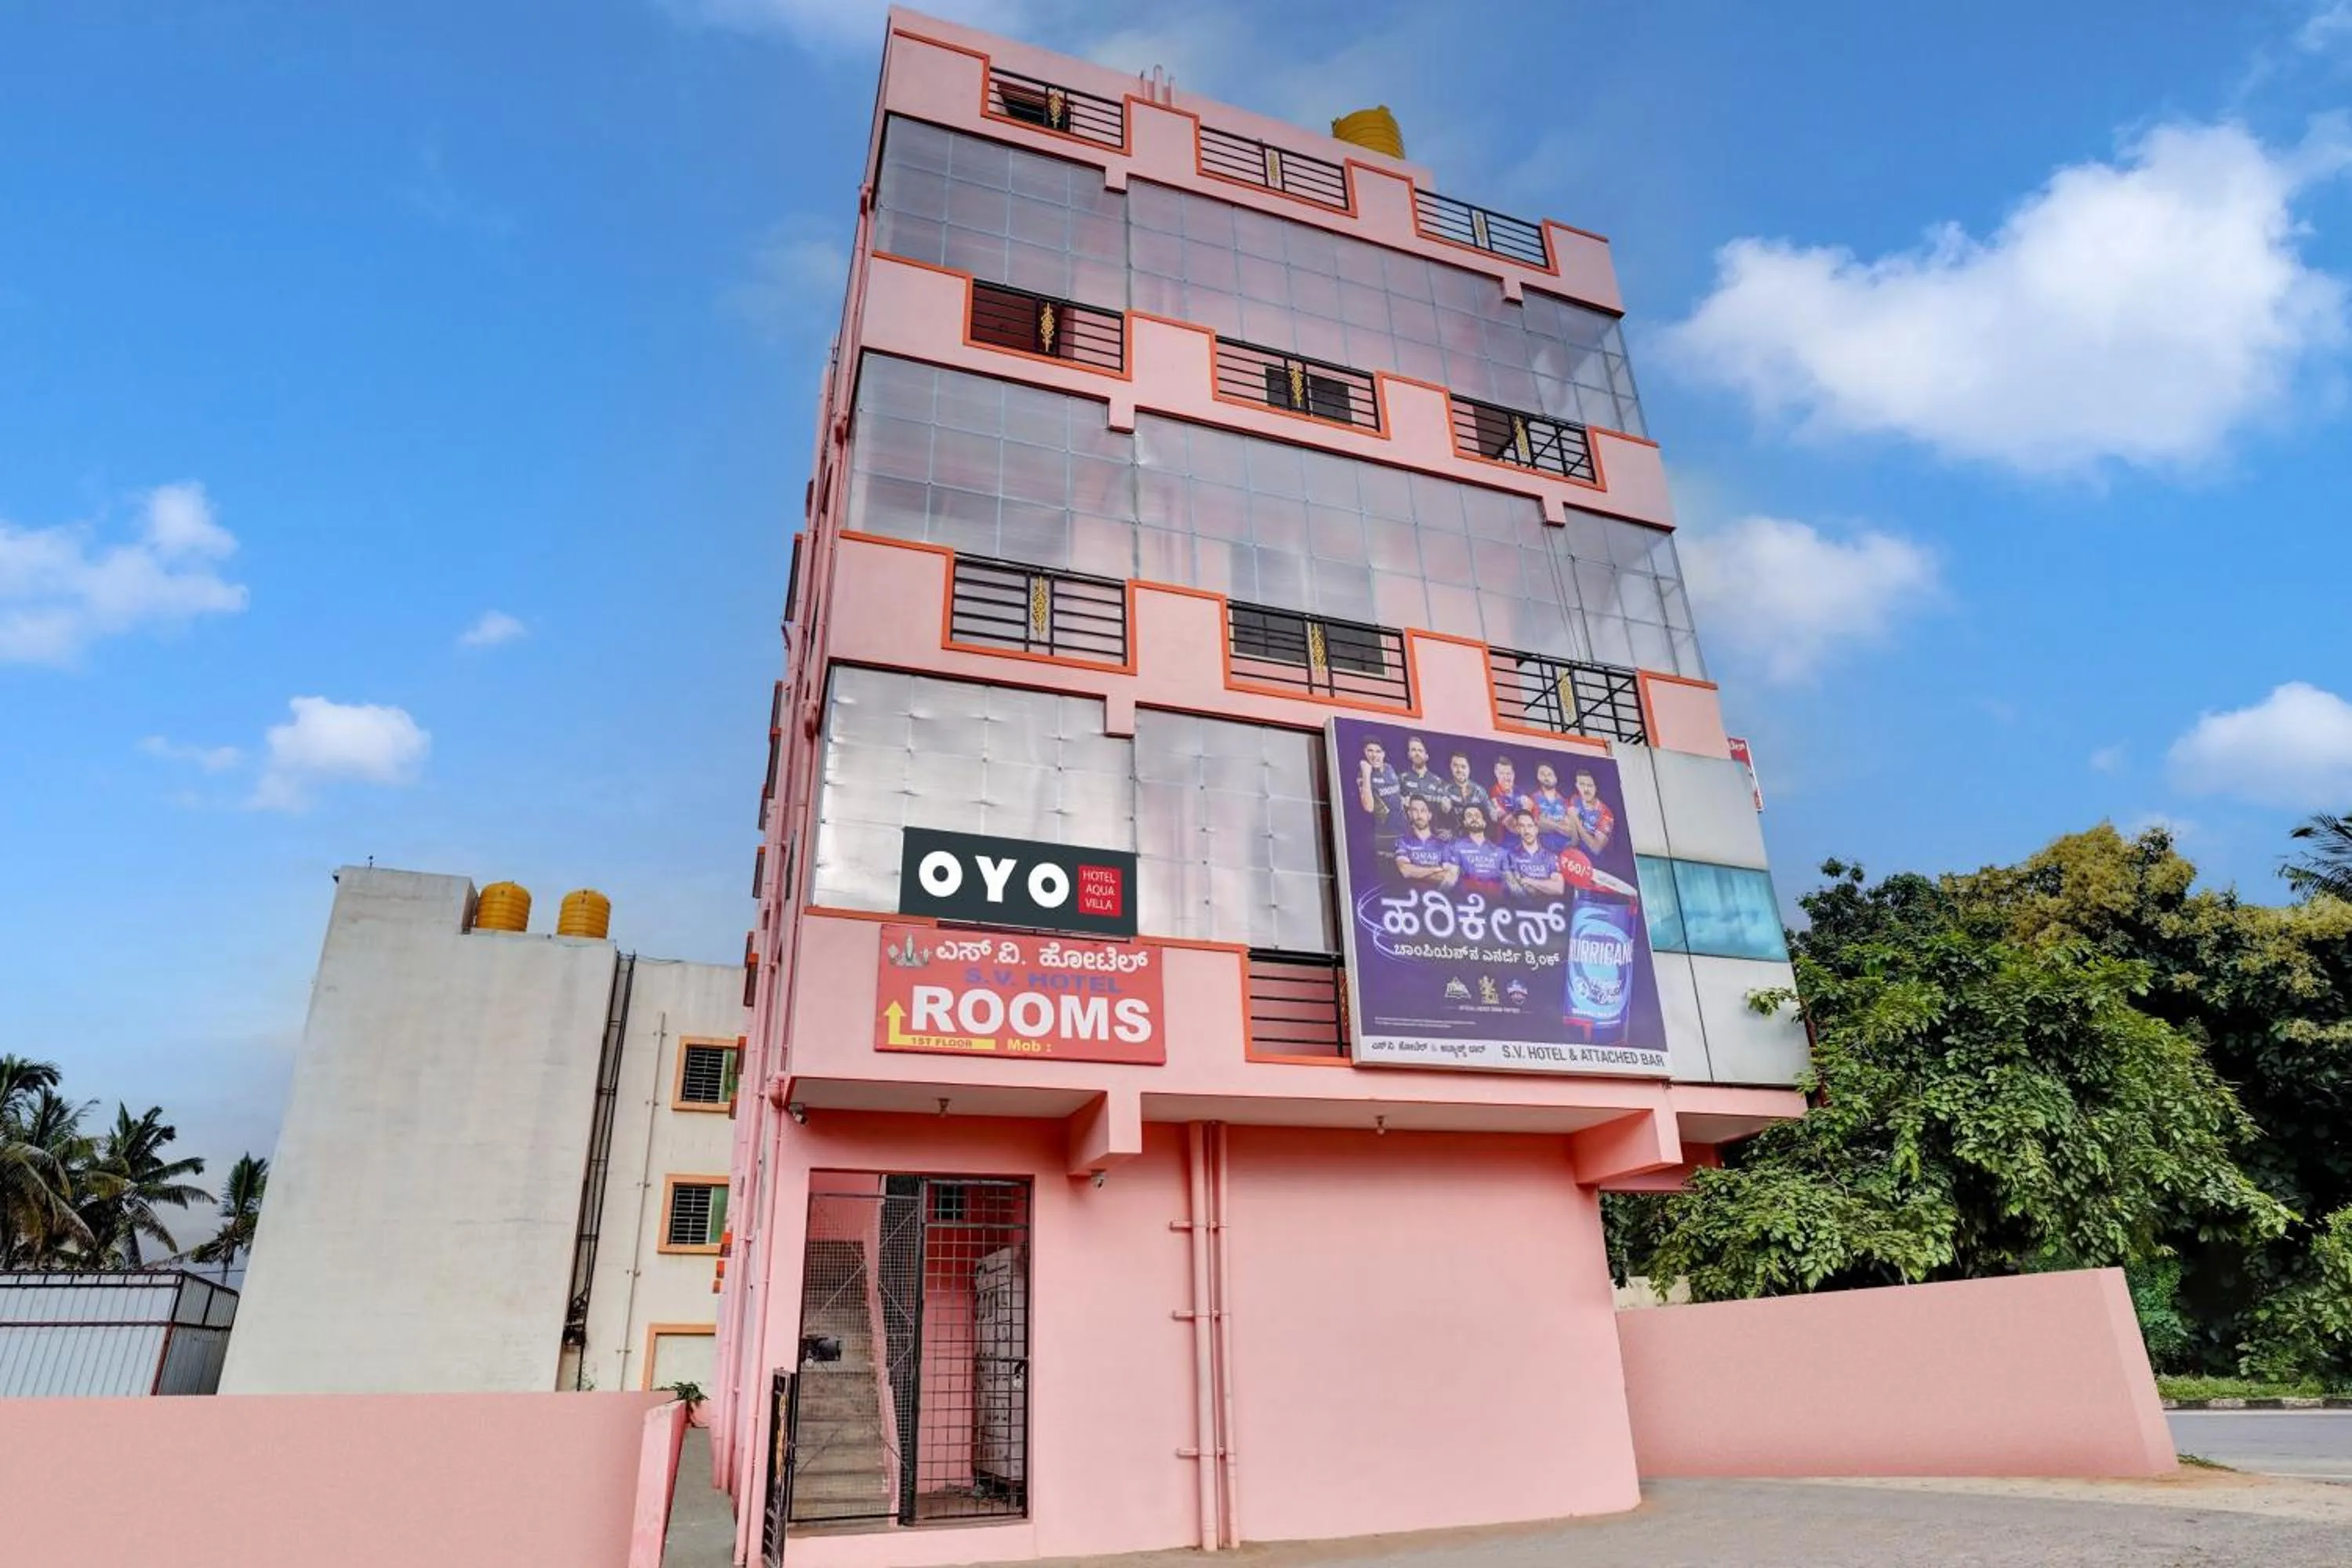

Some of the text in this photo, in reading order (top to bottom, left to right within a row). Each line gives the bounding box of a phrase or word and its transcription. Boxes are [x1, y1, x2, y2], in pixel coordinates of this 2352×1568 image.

[919, 851, 1069, 908] OYO
[1083, 871, 1116, 884] HOTEL
[1086, 884, 1115, 897] AQUA
[1085, 897, 1112, 910] VILLA
[1381, 889, 1566, 946] ಹರಿಕೇನ್
[1039, 942, 1149, 973] ಹೋಟೆಲ್
[1027, 972, 1124, 994] HOTEL
[912, 985, 1152, 1043] ROOMS
[911, 1036, 931, 1045] 1ST
[935, 1038, 973, 1048] FLOOR
[1502, 1045, 1664, 1067] S.V. HOTEL & ATTACHED BAR
